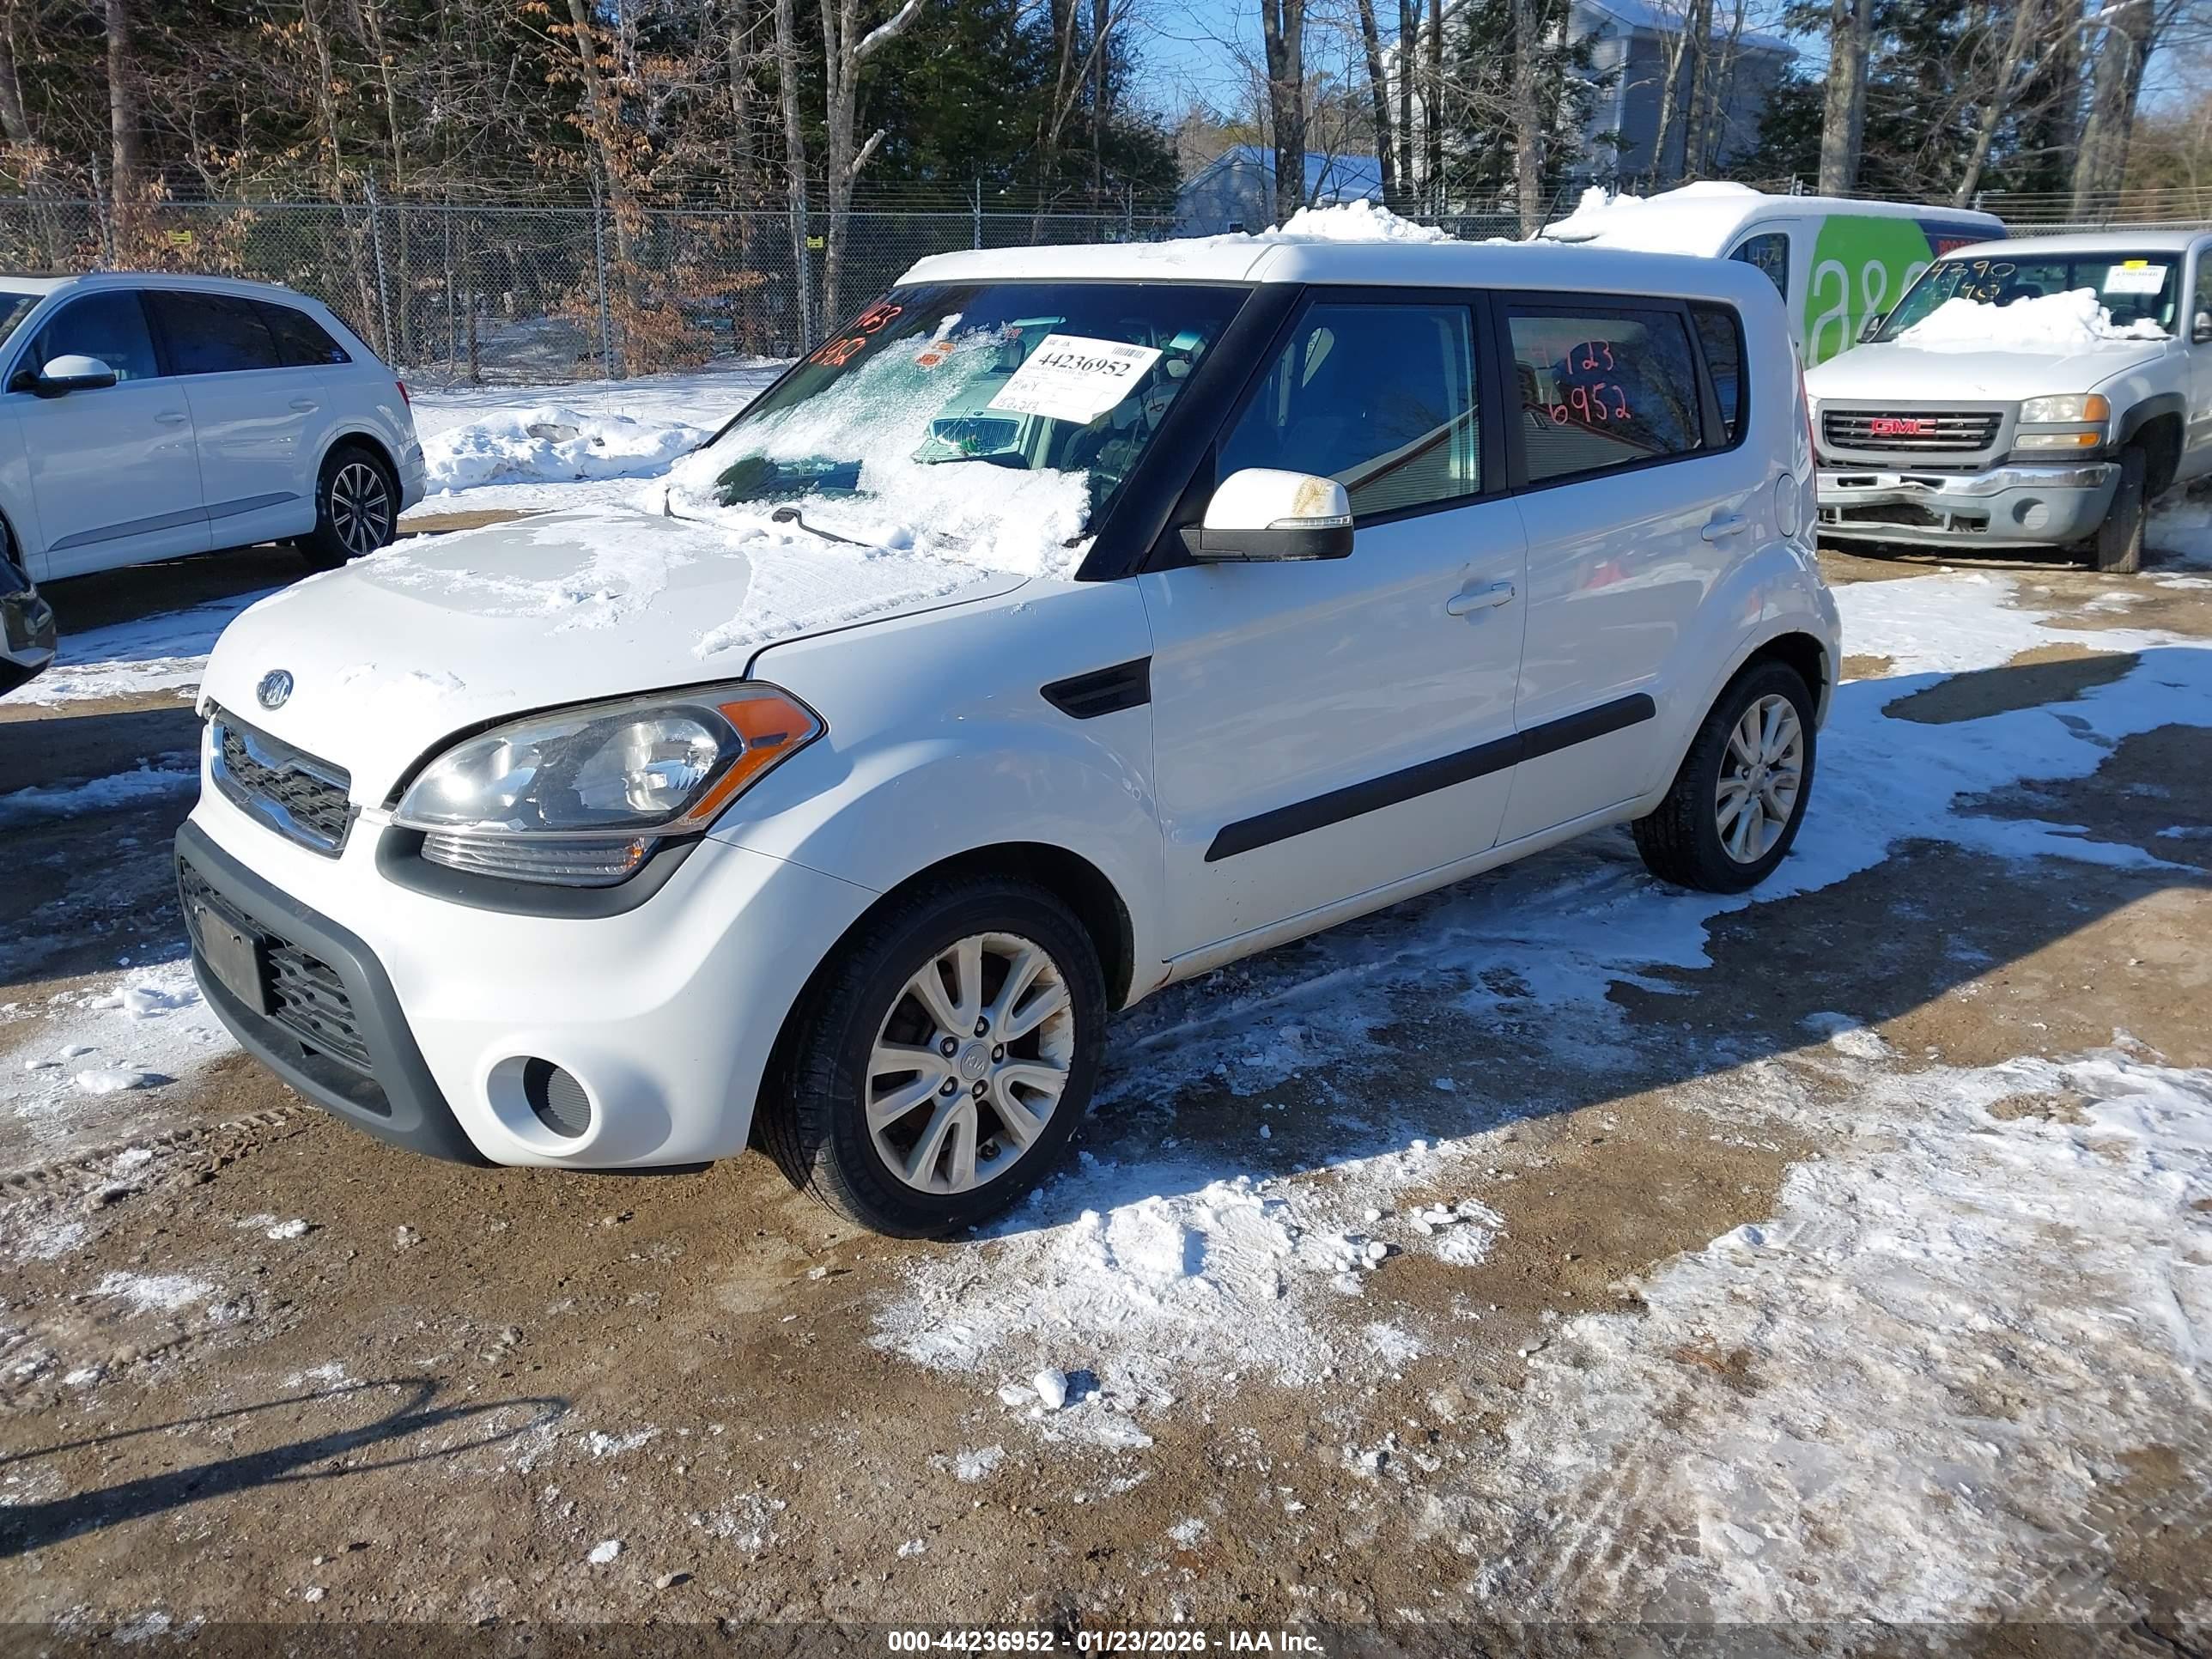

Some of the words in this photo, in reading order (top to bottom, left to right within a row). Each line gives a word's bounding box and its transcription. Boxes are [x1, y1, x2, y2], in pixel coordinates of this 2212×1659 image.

[1038, 352, 1132, 377] 44236952
[1548, 382, 1632, 426] 6952
[1870, 418, 1937, 435] GMC
[963, 1055, 985, 1072] KIA
